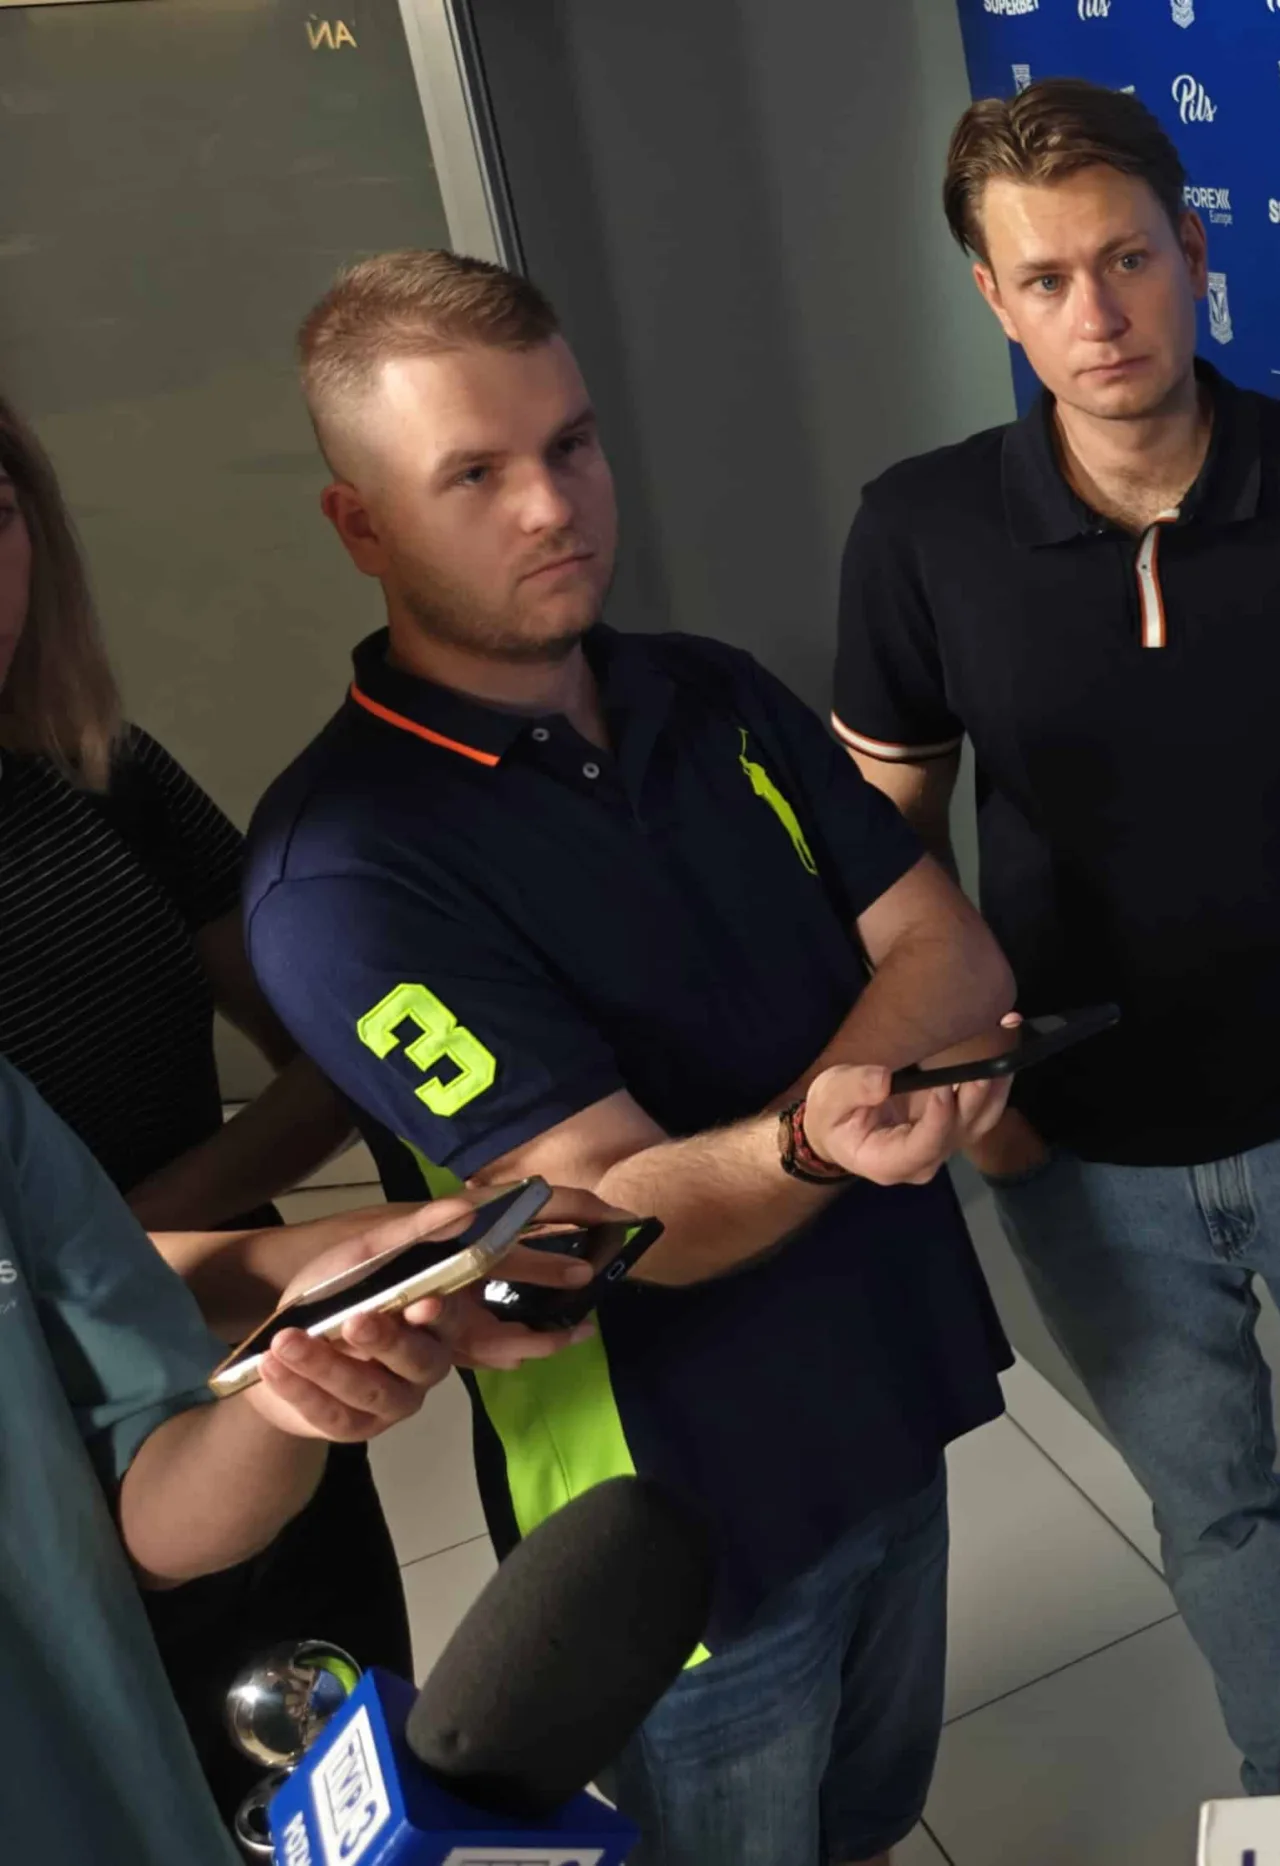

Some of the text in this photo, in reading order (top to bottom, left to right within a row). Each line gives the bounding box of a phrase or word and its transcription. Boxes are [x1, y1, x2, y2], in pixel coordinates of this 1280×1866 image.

[1172, 74, 1217, 124] Pils
[1183, 186, 1231, 209] FOREX
[357, 983, 496, 1117] 3
